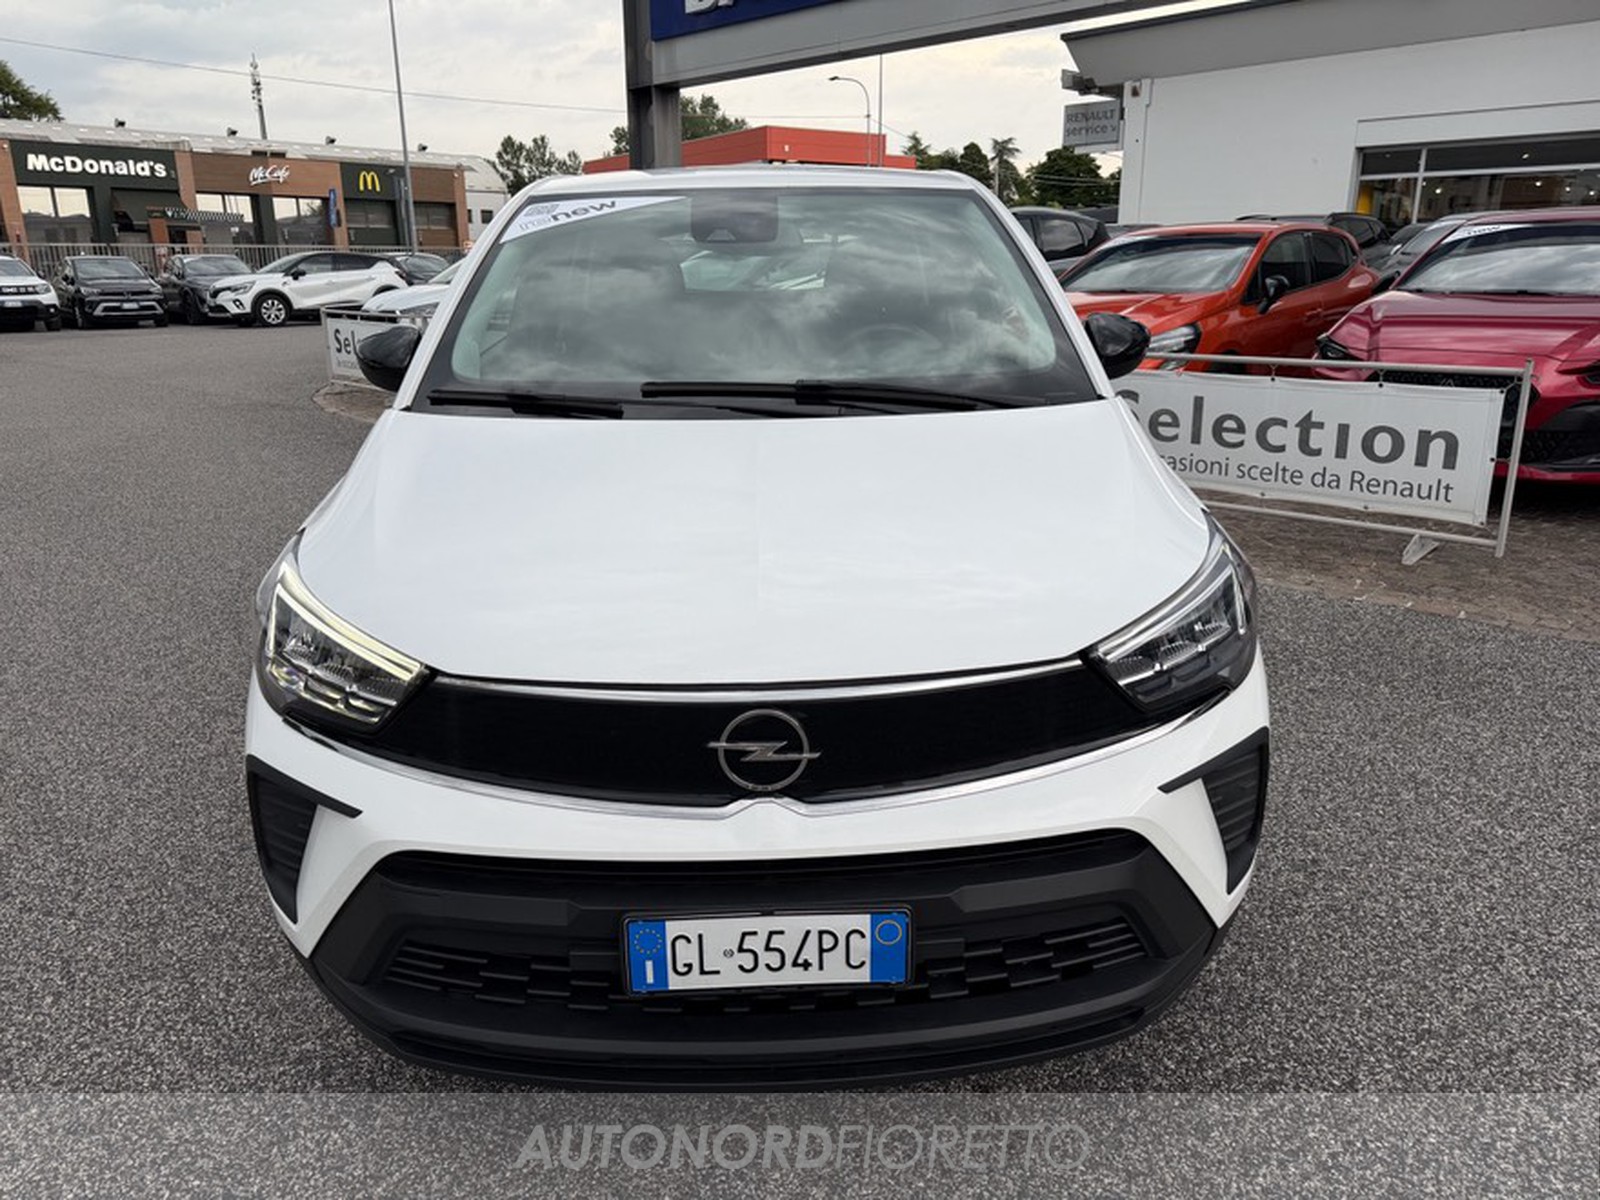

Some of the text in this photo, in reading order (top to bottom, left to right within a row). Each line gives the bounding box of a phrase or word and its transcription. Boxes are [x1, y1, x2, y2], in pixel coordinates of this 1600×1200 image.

[1066, 109, 1116, 123] RENAULT
[1066, 124, 1108, 137] service
[26, 153, 167, 178] McDonald's
[334, 328, 357, 355] Sel
[1160, 453, 1454, 503] asioni scelte da Renault
